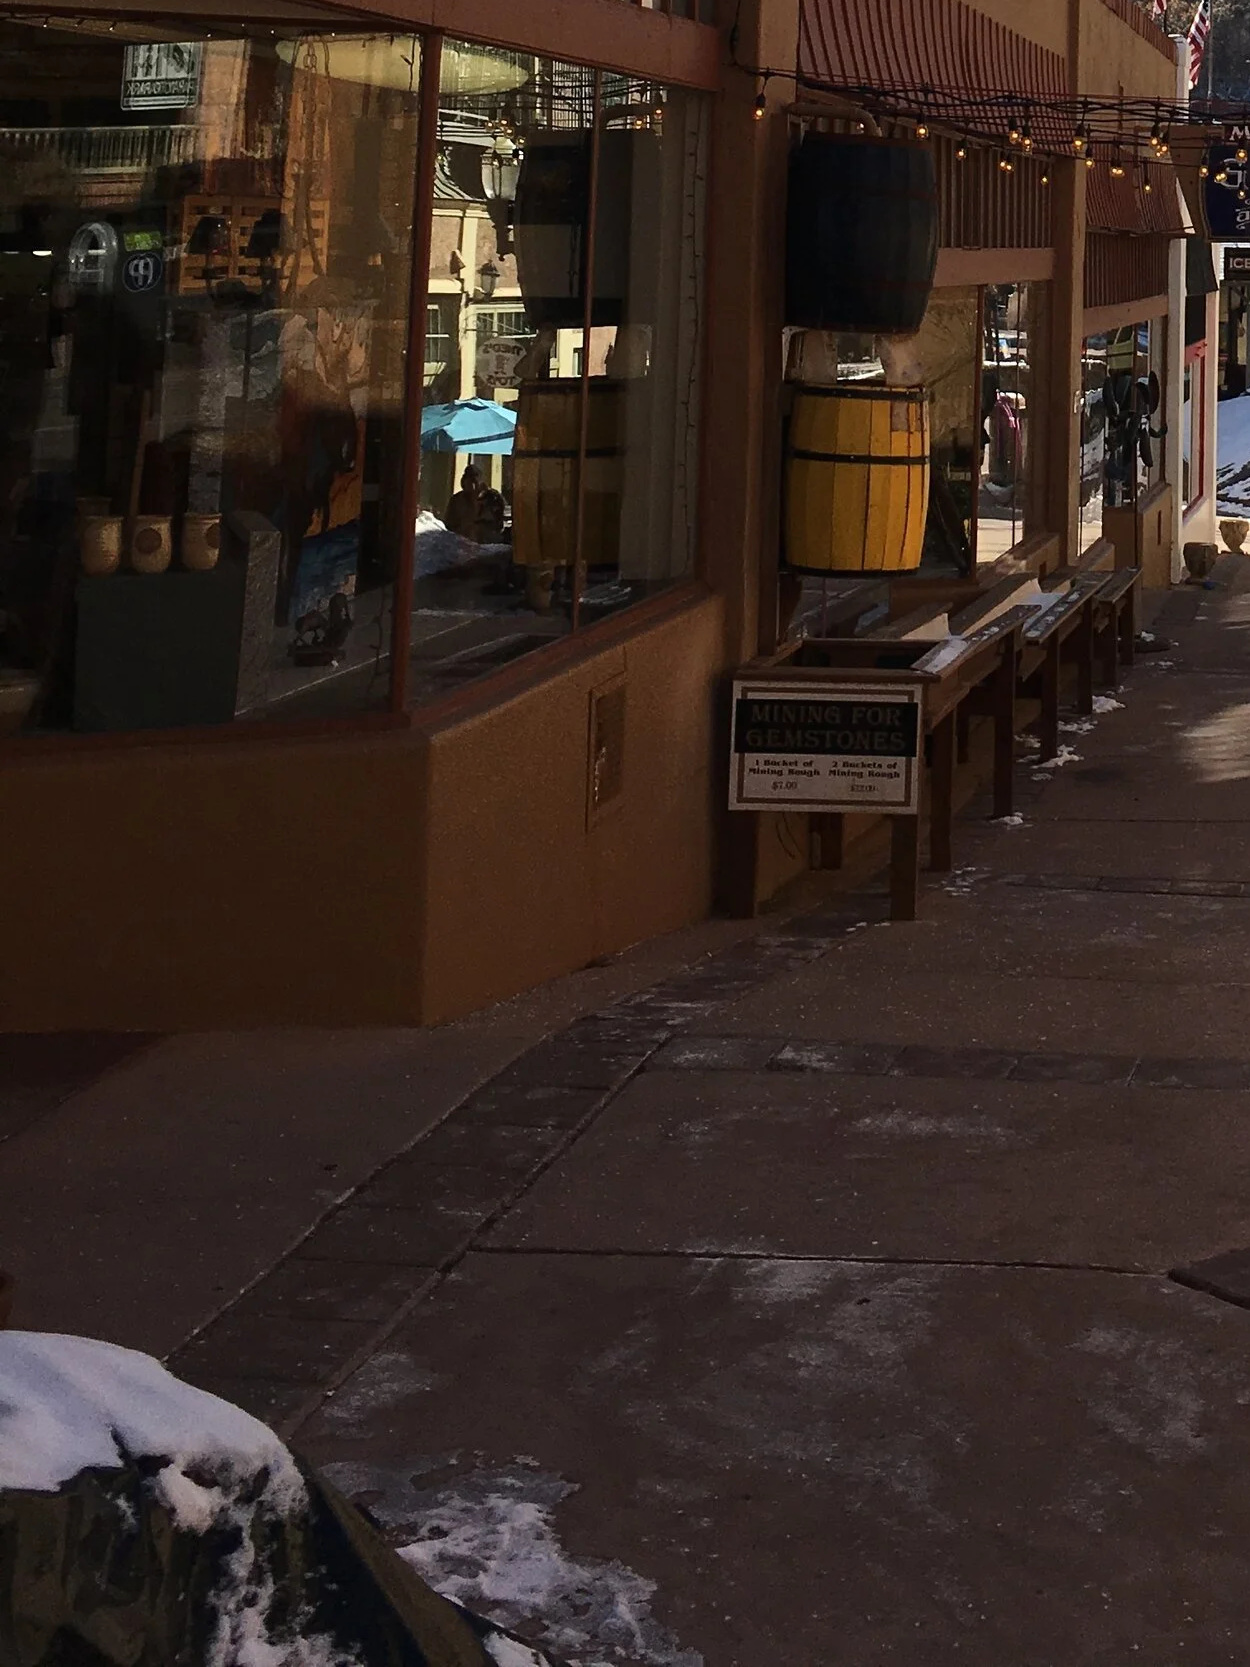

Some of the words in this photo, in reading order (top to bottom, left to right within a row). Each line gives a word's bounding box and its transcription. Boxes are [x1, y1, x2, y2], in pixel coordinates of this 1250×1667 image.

[752, 704, 841, 724] MINING
[852, 706, 900, 725] FOR
[745, 728, 905, 751] GEMSTONES
[764, 759, 798, 768] Bucket
[802, 760, 815, 768] of
[843, 761, 883, 769] Buckets
[887, 761, 898, 770] of
[749, 768, 784, 777] Mining
[787, 769, 820, 778] Rough
[828, 769, 864, 779] Mining
[867, 770, 900, 779] Rough
